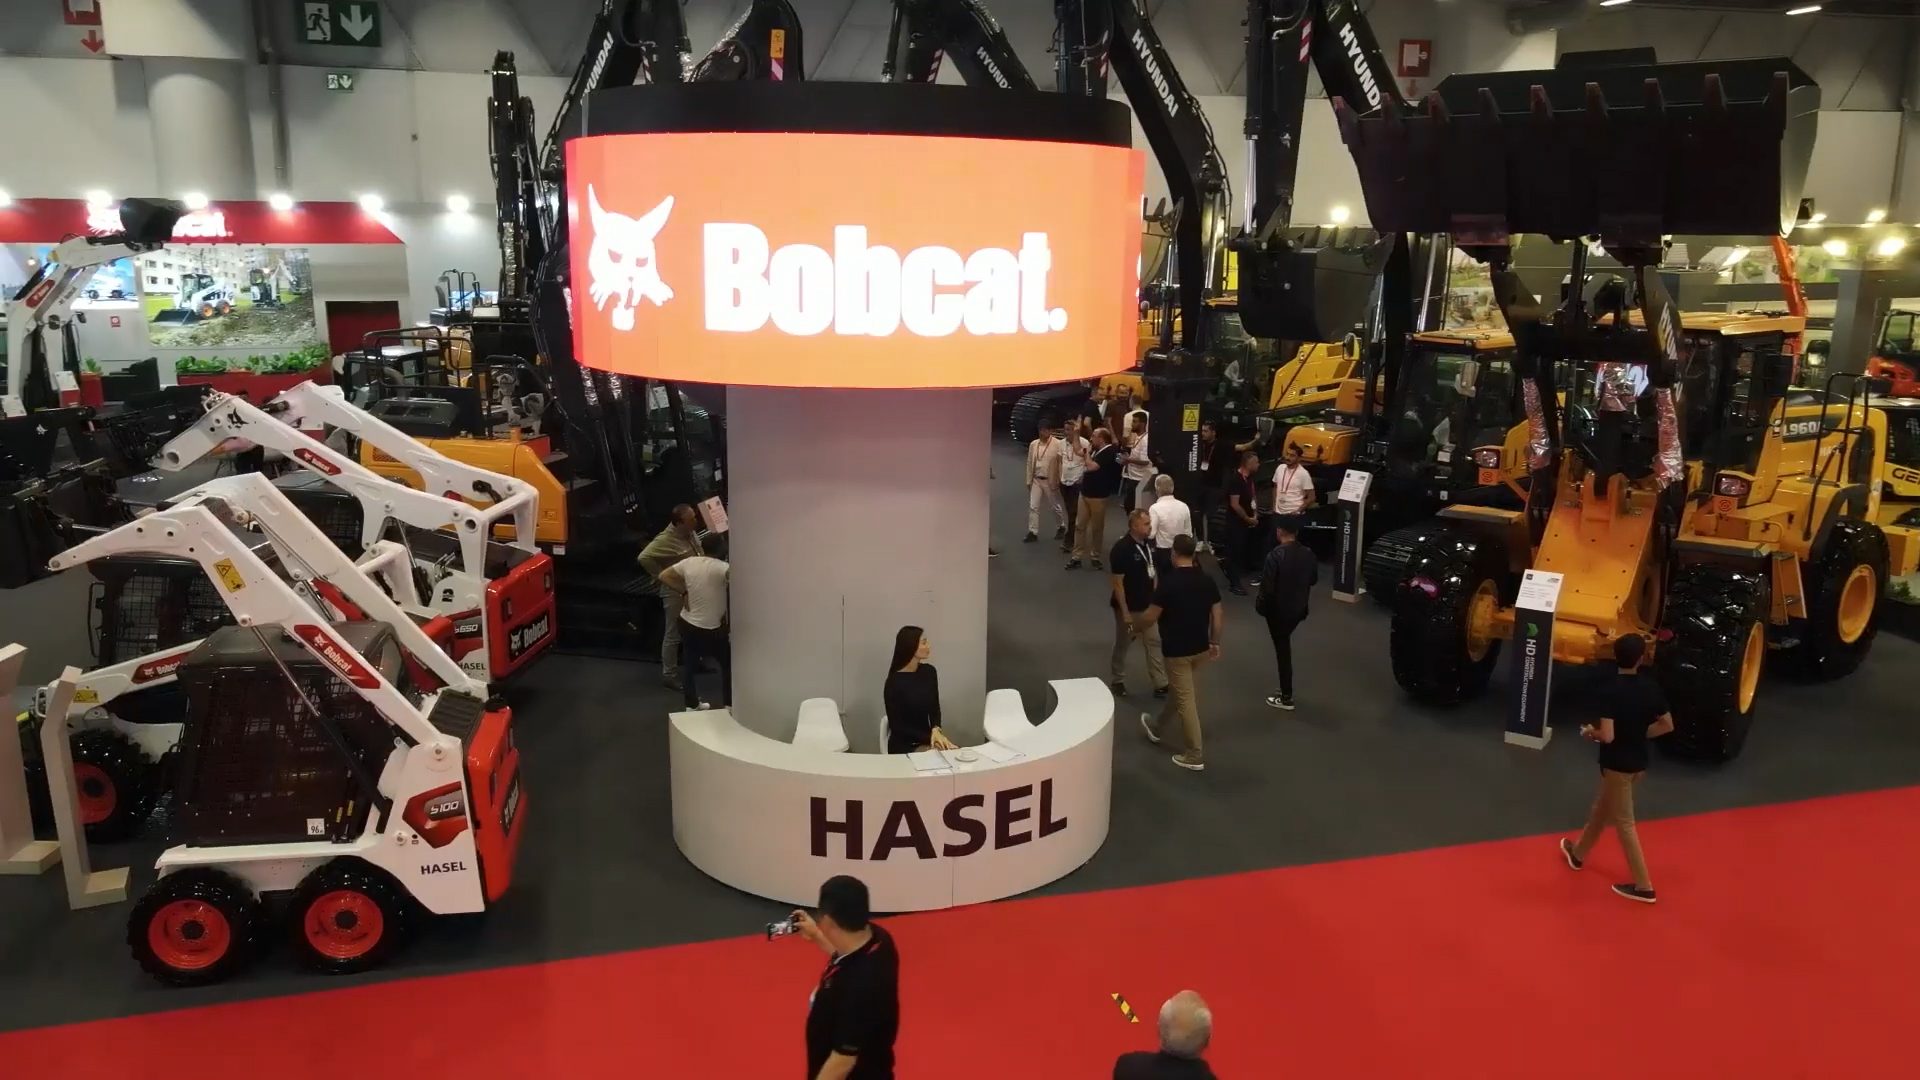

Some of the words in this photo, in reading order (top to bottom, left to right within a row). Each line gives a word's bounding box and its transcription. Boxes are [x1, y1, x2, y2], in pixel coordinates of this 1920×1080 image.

[976, 46, 1011, 88] HYUND
[1132, 28, 1179, 118] HYUNDAI
[1339, 22, 1381, 110] HYUND
[1892, 467, 1920, 485] GE
[323, 645, 353, 672] Bobcat
[1526, 638, 1537, 656] HD
[430, 801, 459, 815] S100
[810, 777, 1067, 861] HASEL
[420, 861, 467, 875] HASEL
